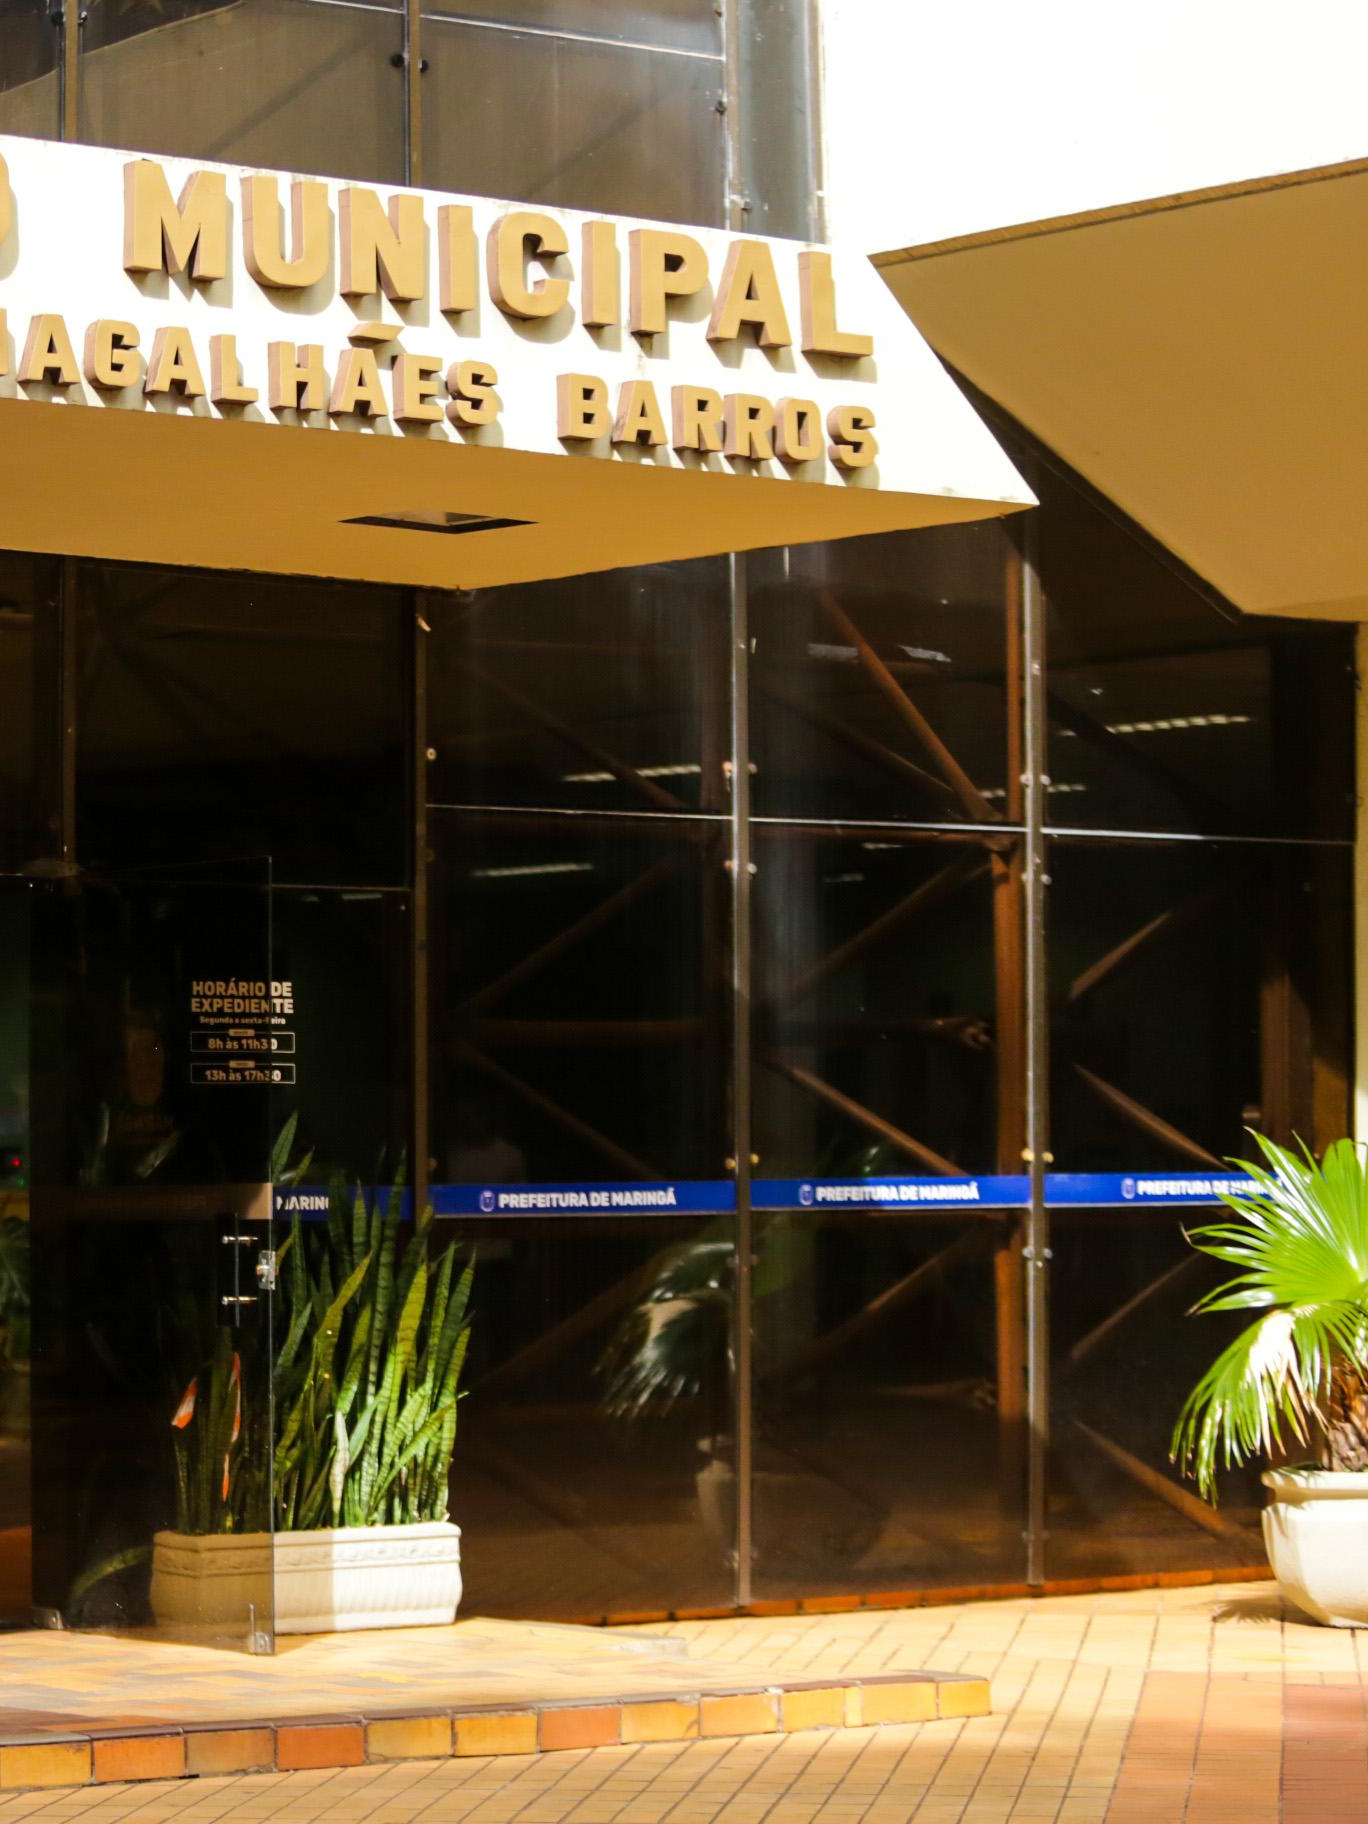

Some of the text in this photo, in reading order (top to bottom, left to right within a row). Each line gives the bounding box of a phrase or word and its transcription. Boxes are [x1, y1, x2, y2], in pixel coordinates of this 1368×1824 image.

[123, 159, 874, 361] MUNICIPAL
[556, 372, 878, 469] BARROS
[191, 977, 293, 997] HORÁRIO DE
[191, 998, 294, 1014] EXPEDIENTE
[207, 1038, 279, 1050] 8h às 11h30
[205, 1069, 282, 1082] 13h às 17h30
[815, 1181, 980, 1201] PREFEITURA DE MARINGÁ
[1137, 1180, 1212, 1195] PREFEITURA
[276, 1194, 329, 1211] MARIN
[498, 1187, 677, 1208] PREFEITURA DE MARINGÁ
